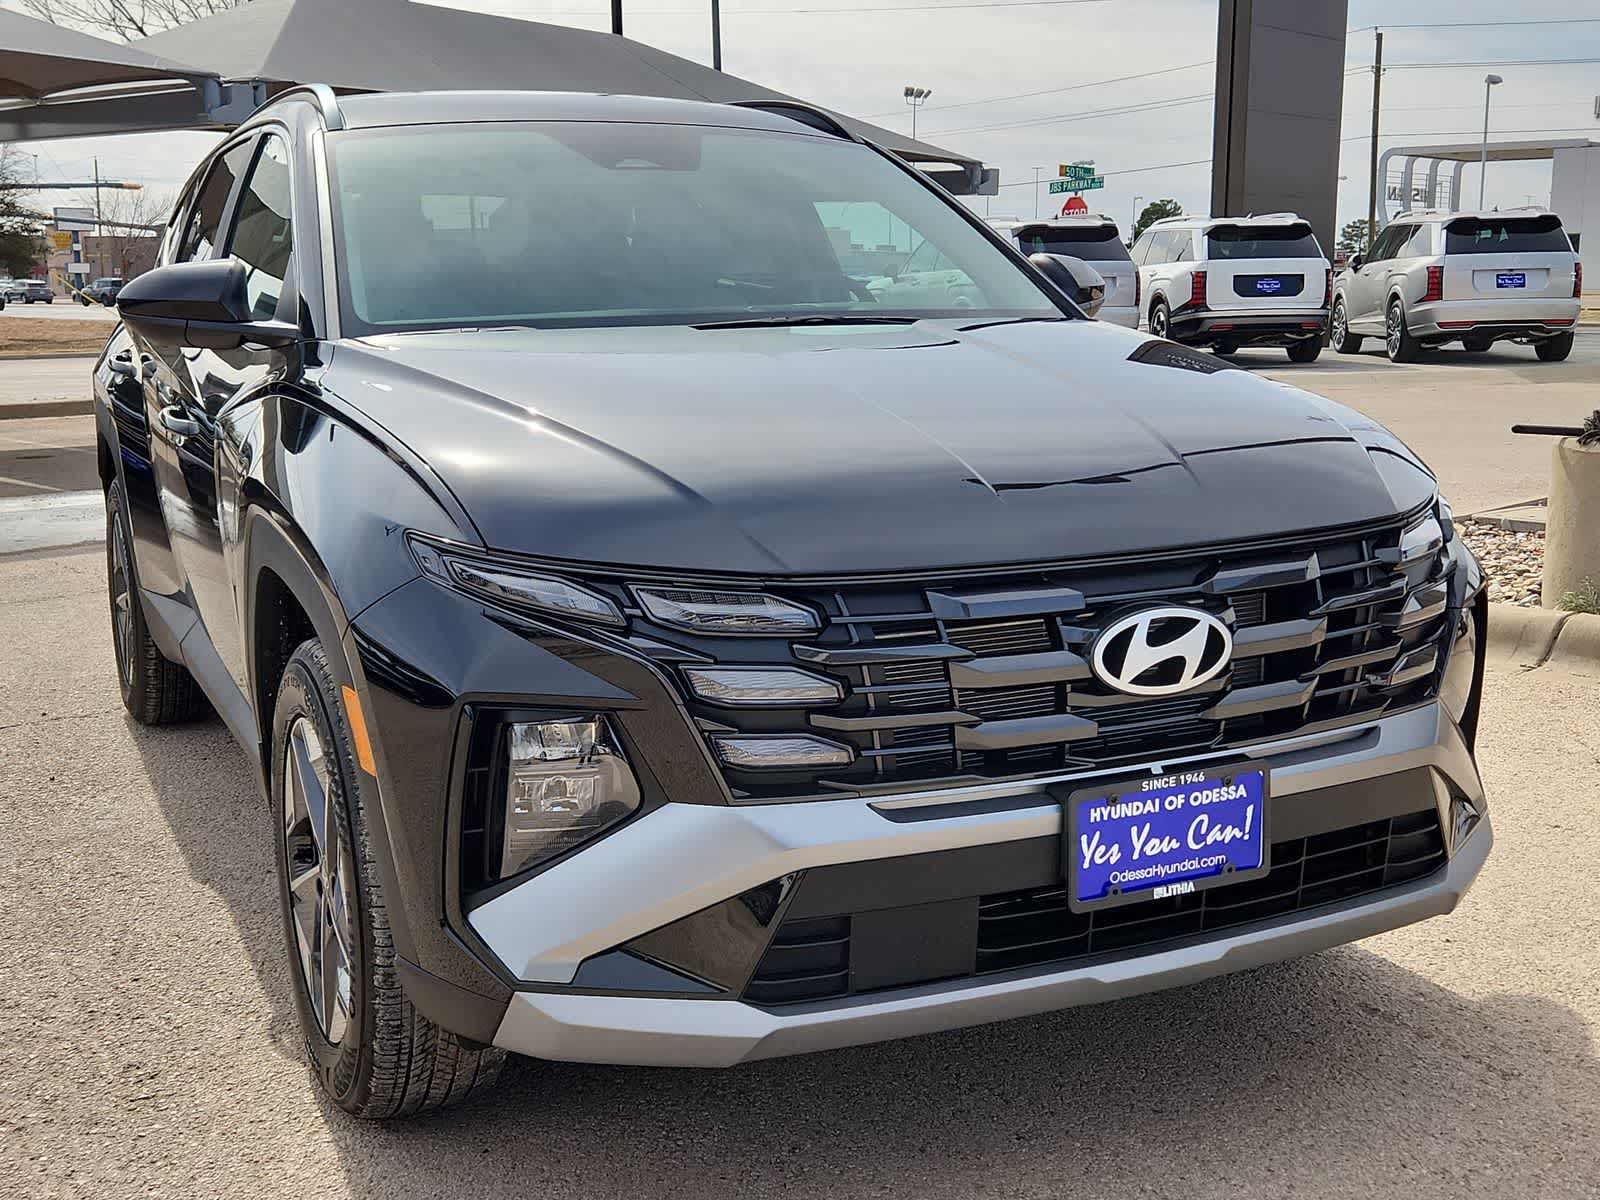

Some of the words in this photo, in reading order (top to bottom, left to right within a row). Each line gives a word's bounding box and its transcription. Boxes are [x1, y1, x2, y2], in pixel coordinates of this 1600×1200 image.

[1050, 182, 1062, 193] JBS
[1063, 179, 1092, 192] PARKWAY
[1141, 776, 1177, 792] SINCE
[1179, 772, 1205, 785] 1946
[1090, 798, 1160, 823] HYUNDAI
[1164, 794, 1186, 811] OF
[1189, 784, 1247, 807] ODESSA
[1081, 830, 1121, 869] Yes
[1130, 822, 1180, 860] You
[1187, 804, 1254, 850] Can!
[1109, 854, 1226, 884] OdessaHyundai.com
[1164, 881, 1196, 898] LITHIA
